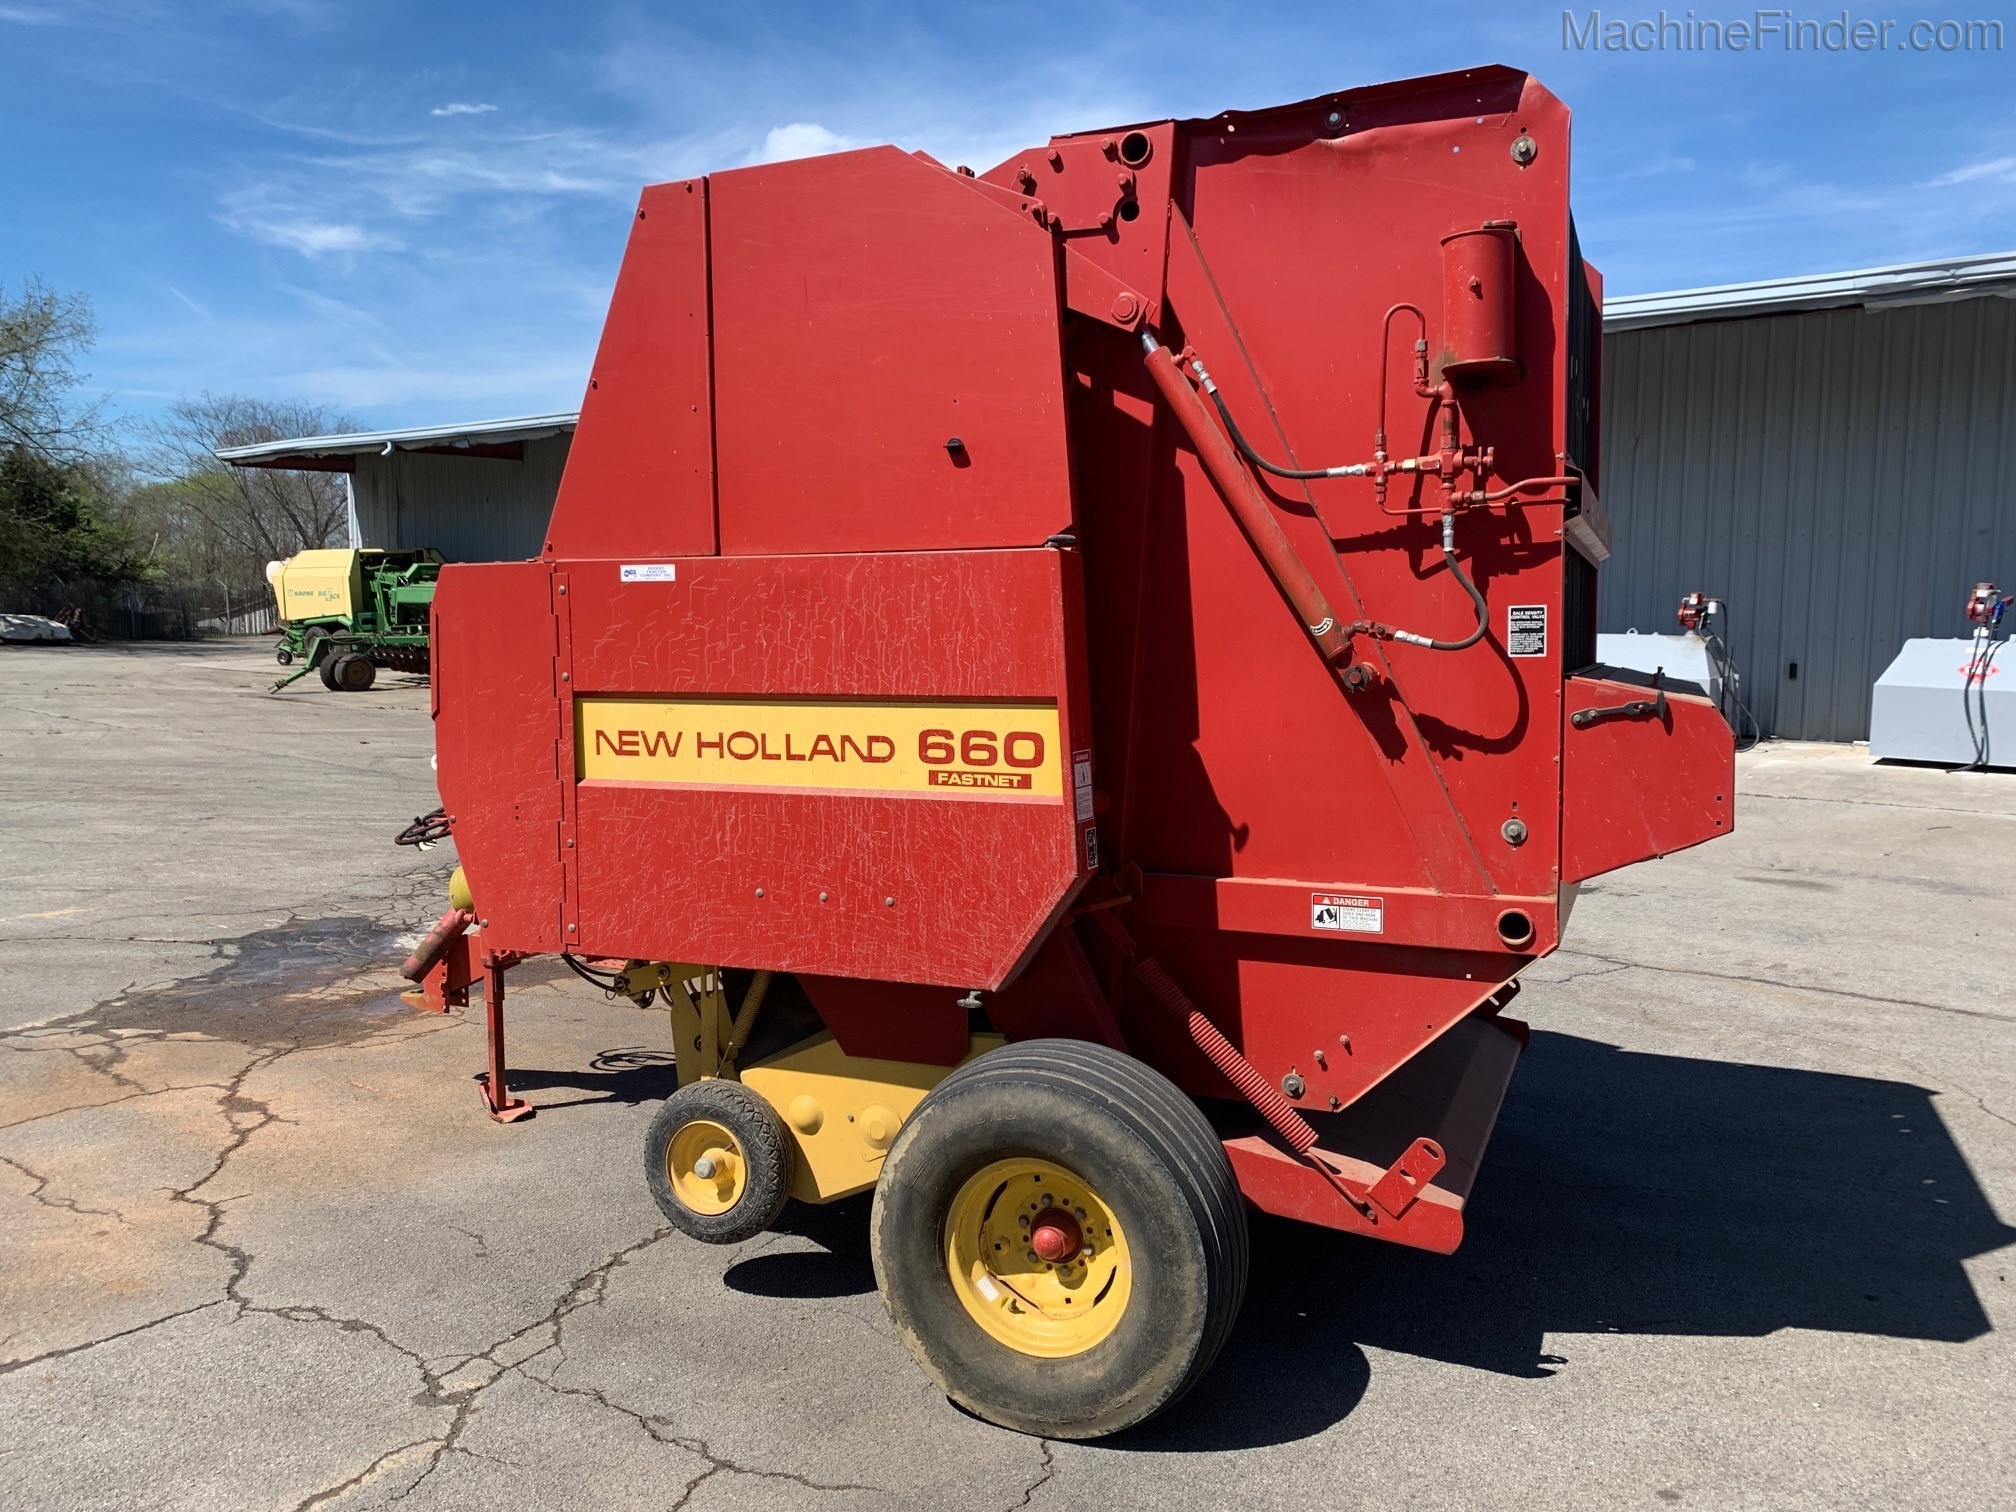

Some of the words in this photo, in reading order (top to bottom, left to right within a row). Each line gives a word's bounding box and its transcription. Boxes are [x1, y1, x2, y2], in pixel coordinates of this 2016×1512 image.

[595, 729, 683, 757] NEW
[697, 731, 896, 764] HOLLAND
[918, 729, 1044, 768] 660
[937, 772, 1022, 788] FASTNET
[1333, 898, 1369, 907] DANGER
